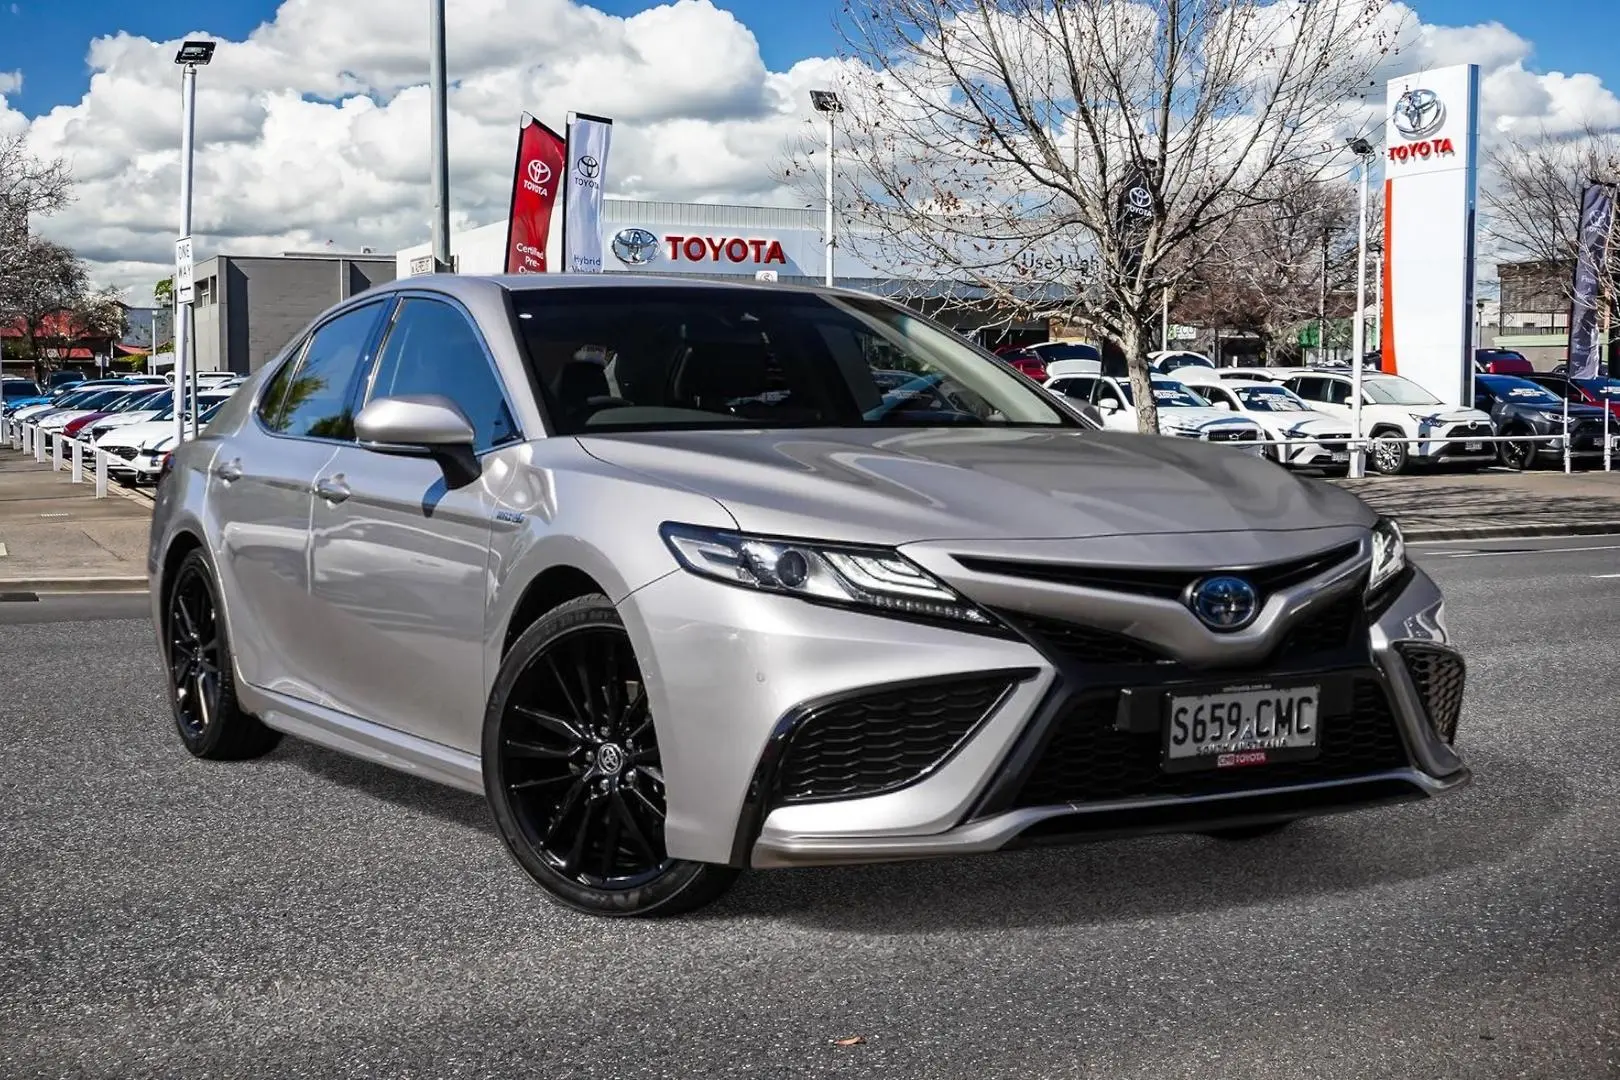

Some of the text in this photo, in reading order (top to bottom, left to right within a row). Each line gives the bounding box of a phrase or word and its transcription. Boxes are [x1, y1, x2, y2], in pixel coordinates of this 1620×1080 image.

[1388, 138, 1454, 161] TOYOTA
[524, 180, 548, 196] TOYOTA
[178, 244, 190, 260] ONE
[665, 236, 786, 264] TOYOTA
[178, 265, 192, 279] WAY
